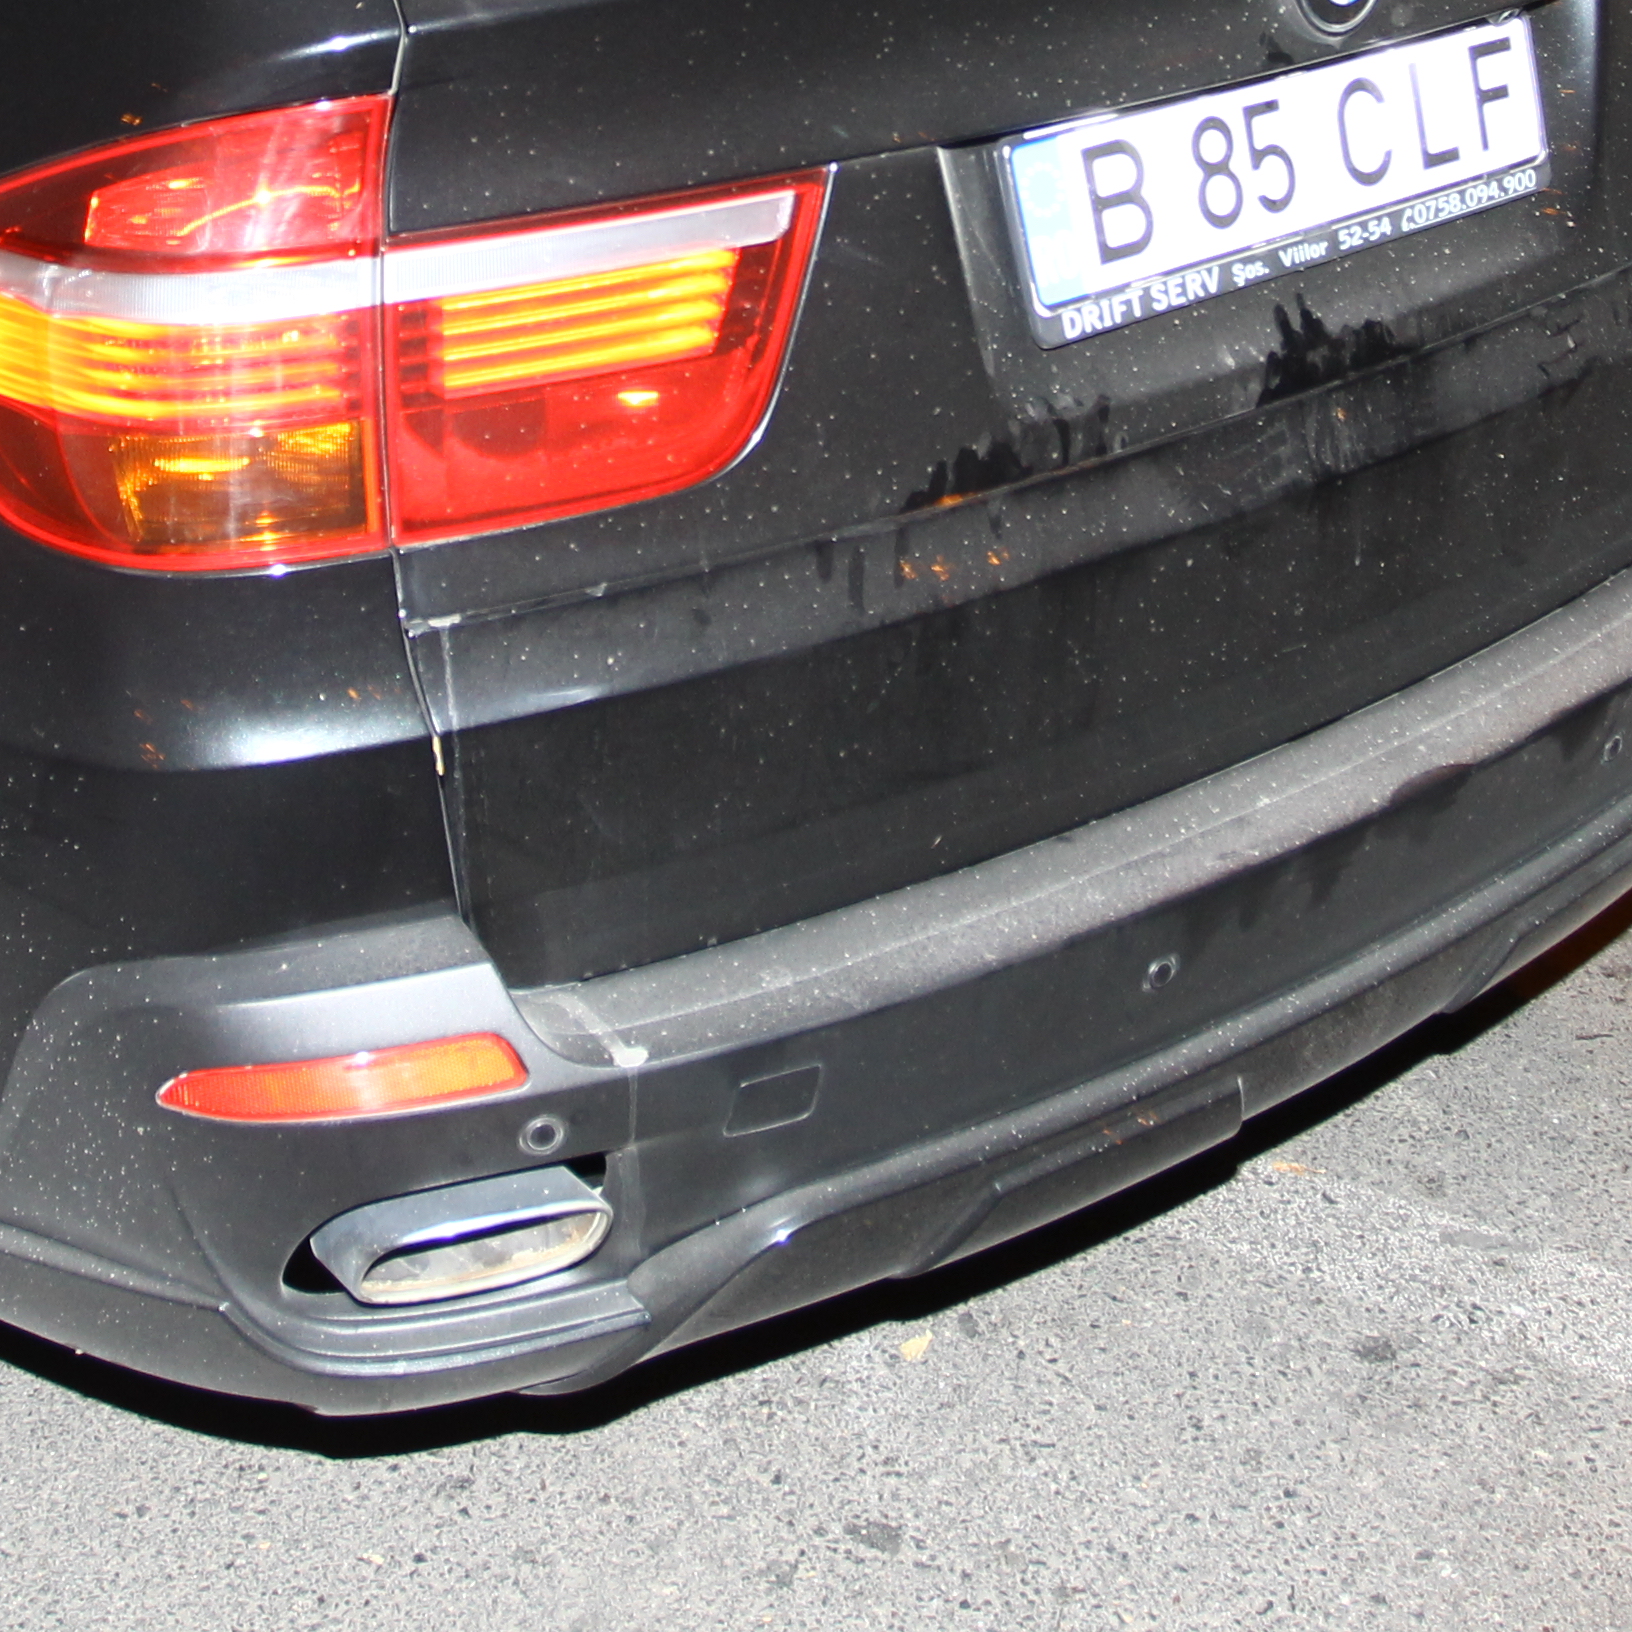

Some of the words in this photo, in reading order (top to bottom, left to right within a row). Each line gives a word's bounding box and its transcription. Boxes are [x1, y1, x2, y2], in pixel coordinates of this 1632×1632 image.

[1081, 139, 1154, 265] B
[1191, 99, 1296, 229] 85
[1336, 37, 1512, 186] CLF
[1061, 288, 1144, 340] DRIFT
[1149, 266, 1221, 312] SERV
[1278, 239, 1329, 267] Viilor
[1337, 216, 1393, 250] 52-54
[1412, 168, 1538, 225] 0758.094.900
